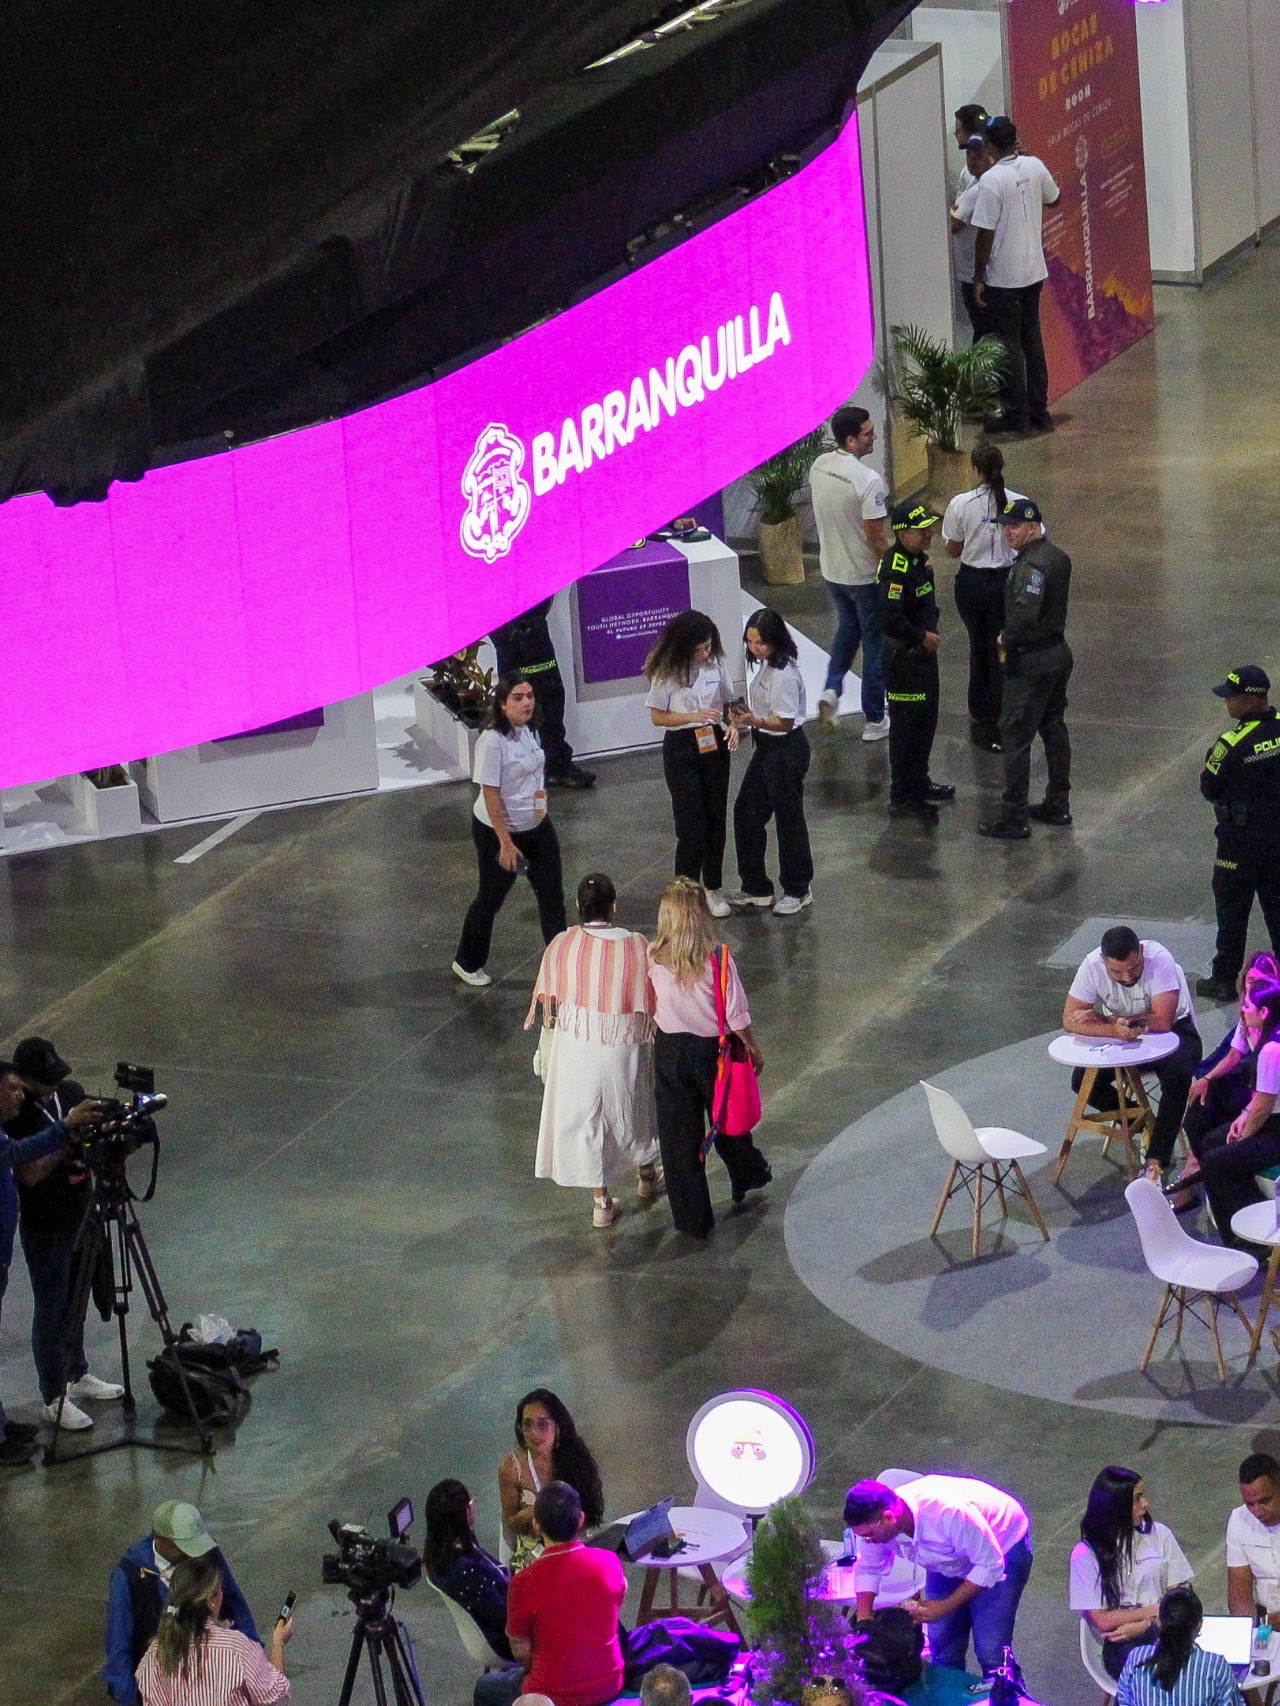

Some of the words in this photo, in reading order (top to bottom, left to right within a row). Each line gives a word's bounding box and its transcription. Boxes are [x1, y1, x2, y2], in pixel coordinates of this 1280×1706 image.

[1051, 12, 1098, 60] BOCAS
[1038, 70, 1059, 100] DE
[1061, 35, 1114, 85] CENIZA
[1065, 84, 1091, 111] ROOM
[1079, 172, 1096, 320] BARRANQUILLA
[532, 292, 791, 497] BARRANQUILLA
[587, 623, 608, 632] YOUTH
[601, 614, 625, 623] GLOBAL
[627, 607, 670, 619] OPPORTUNITY
